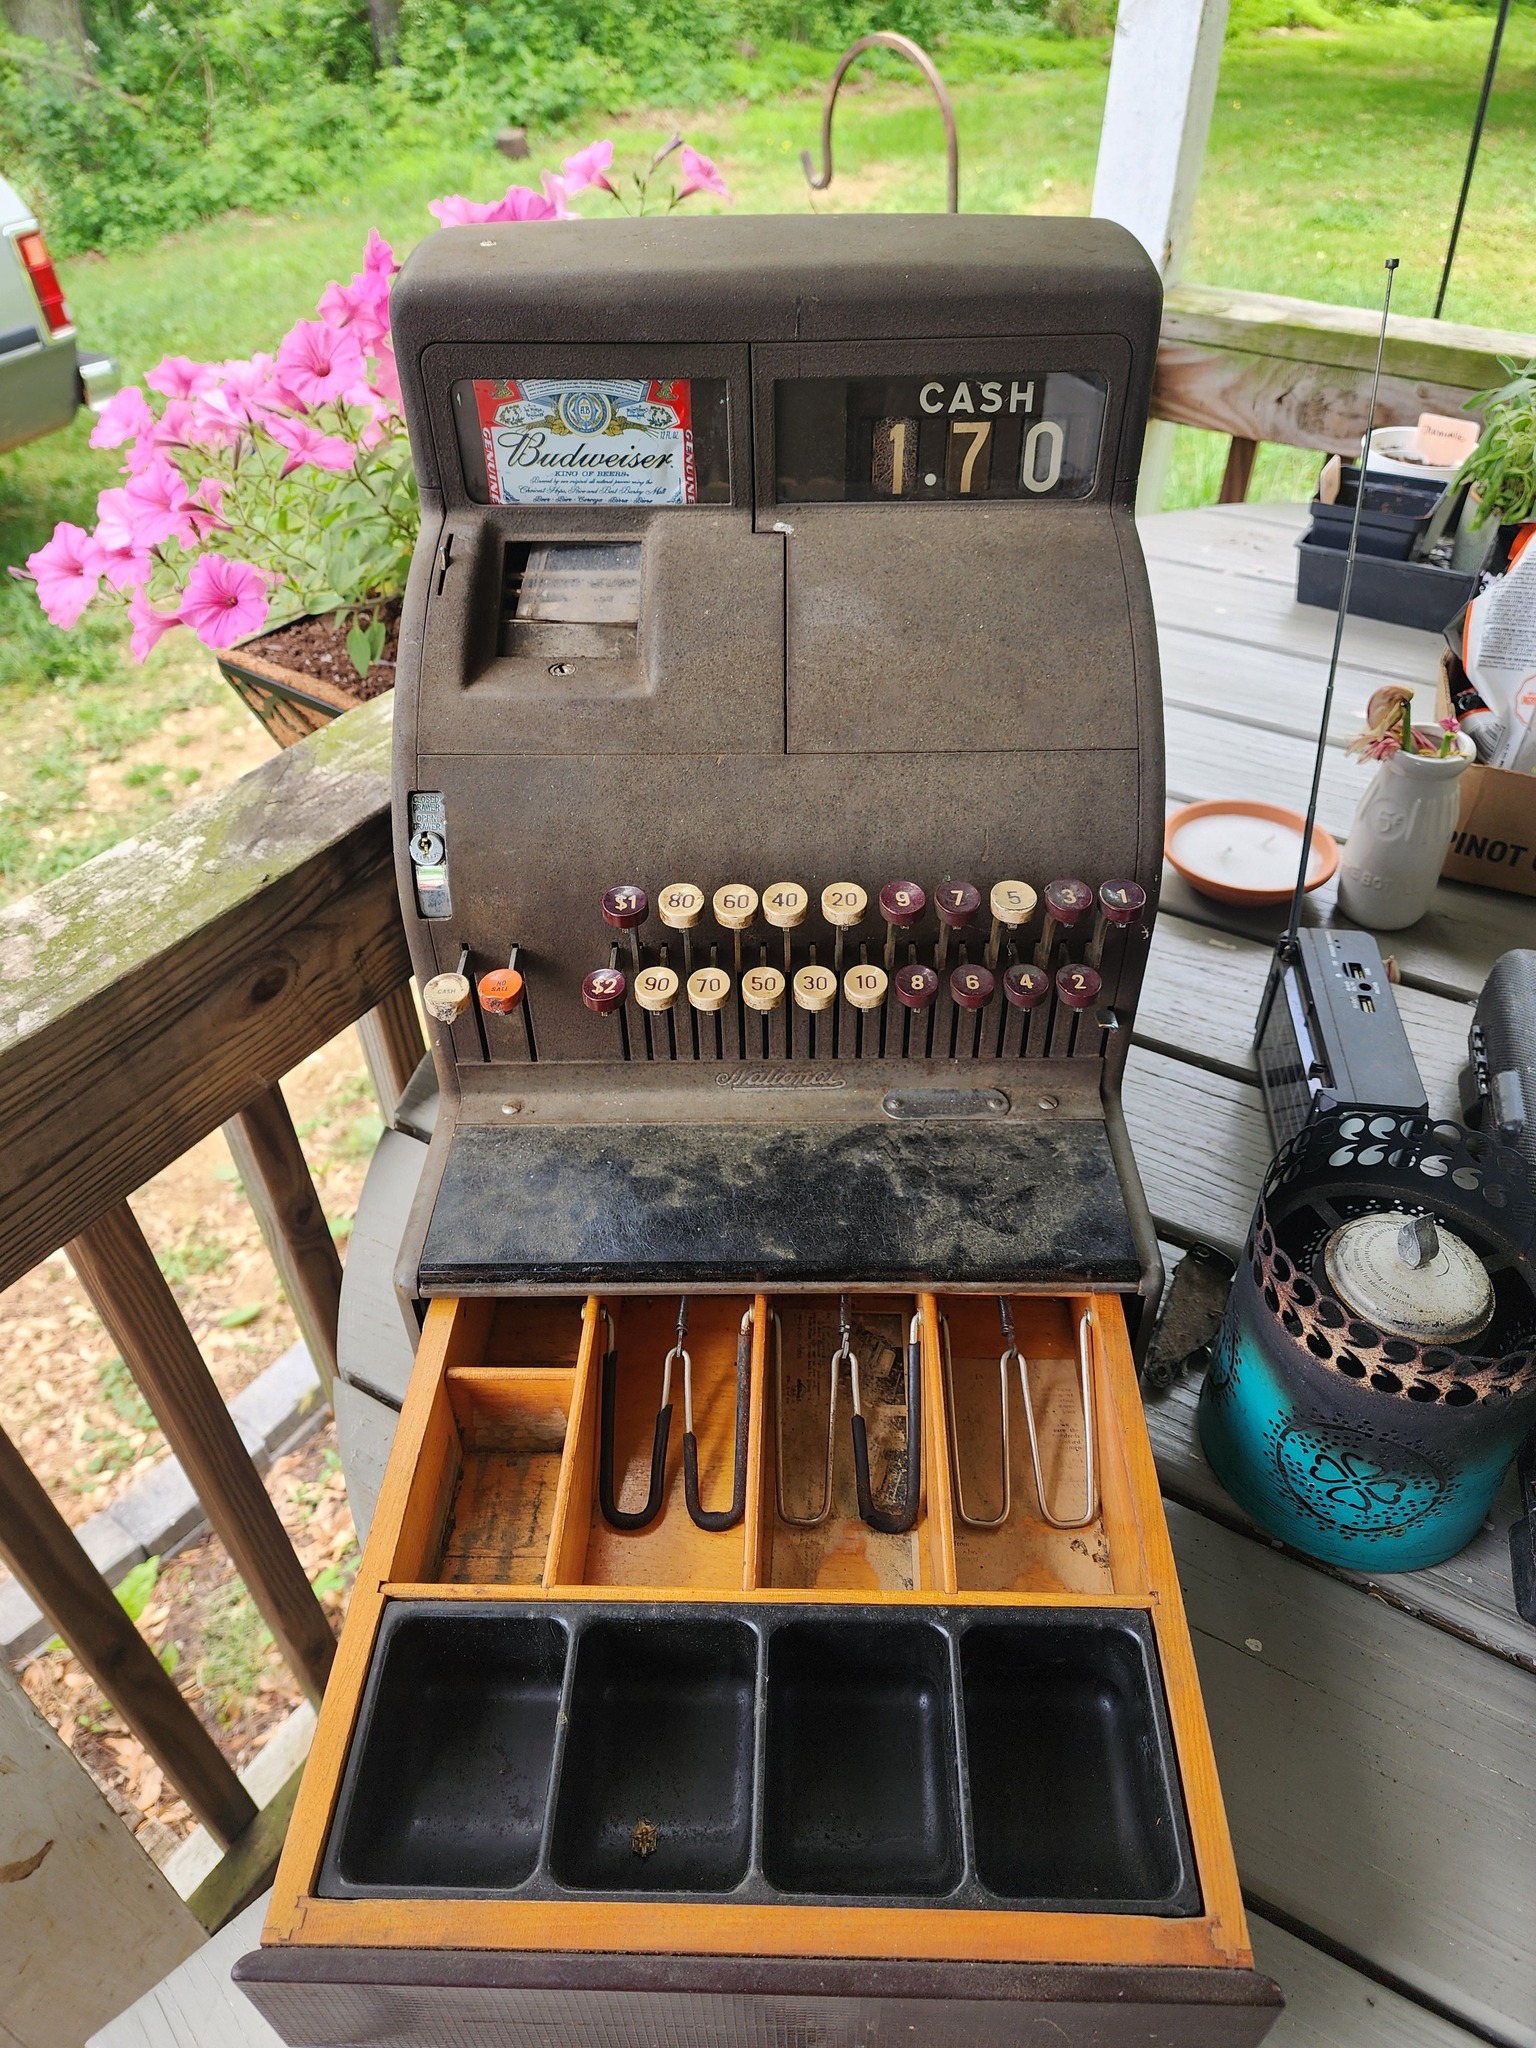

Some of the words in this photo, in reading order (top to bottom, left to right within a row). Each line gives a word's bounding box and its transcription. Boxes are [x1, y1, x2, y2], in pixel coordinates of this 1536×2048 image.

[919, 381, 1034, 413] CASH
[482, 427, 500, 505] GENUINE
[685, 429, 695, 504] GENUINE
[412, 803, 441, 812] DRAWER
[1450, 830, 1528, 868] INOT
[614, 894, 637, 911] $1
[668, 893, 695, 908] 80
[723, 894, 750, 909] 60
[771, 892, 798, 907] 40
[831, 892, 858, 907] 20
[895, 891, 911, 907] 9
[950, 889, 963, 906] 7
[1006, 890, 1021, 905] 5
[1061, 888, 1077, 904] 3
[1116, 888, 1128, 904] 1
[591, 979, 617, 995] $2
[644, 977, 670, 991] 90
[696, 978, 721, 992] 70
[751, 976, 776, 991] 50
[803, 975, 828, 990] 30
[855, 975, 878, 990] 10
[911, 975, 924, 990] 8
[965, 975, 980, 990] 6
[1019, 973, 1034, 990] 4
[1070, 974, 1087, 990] 2
[715, 1068, 847, 1093] National
